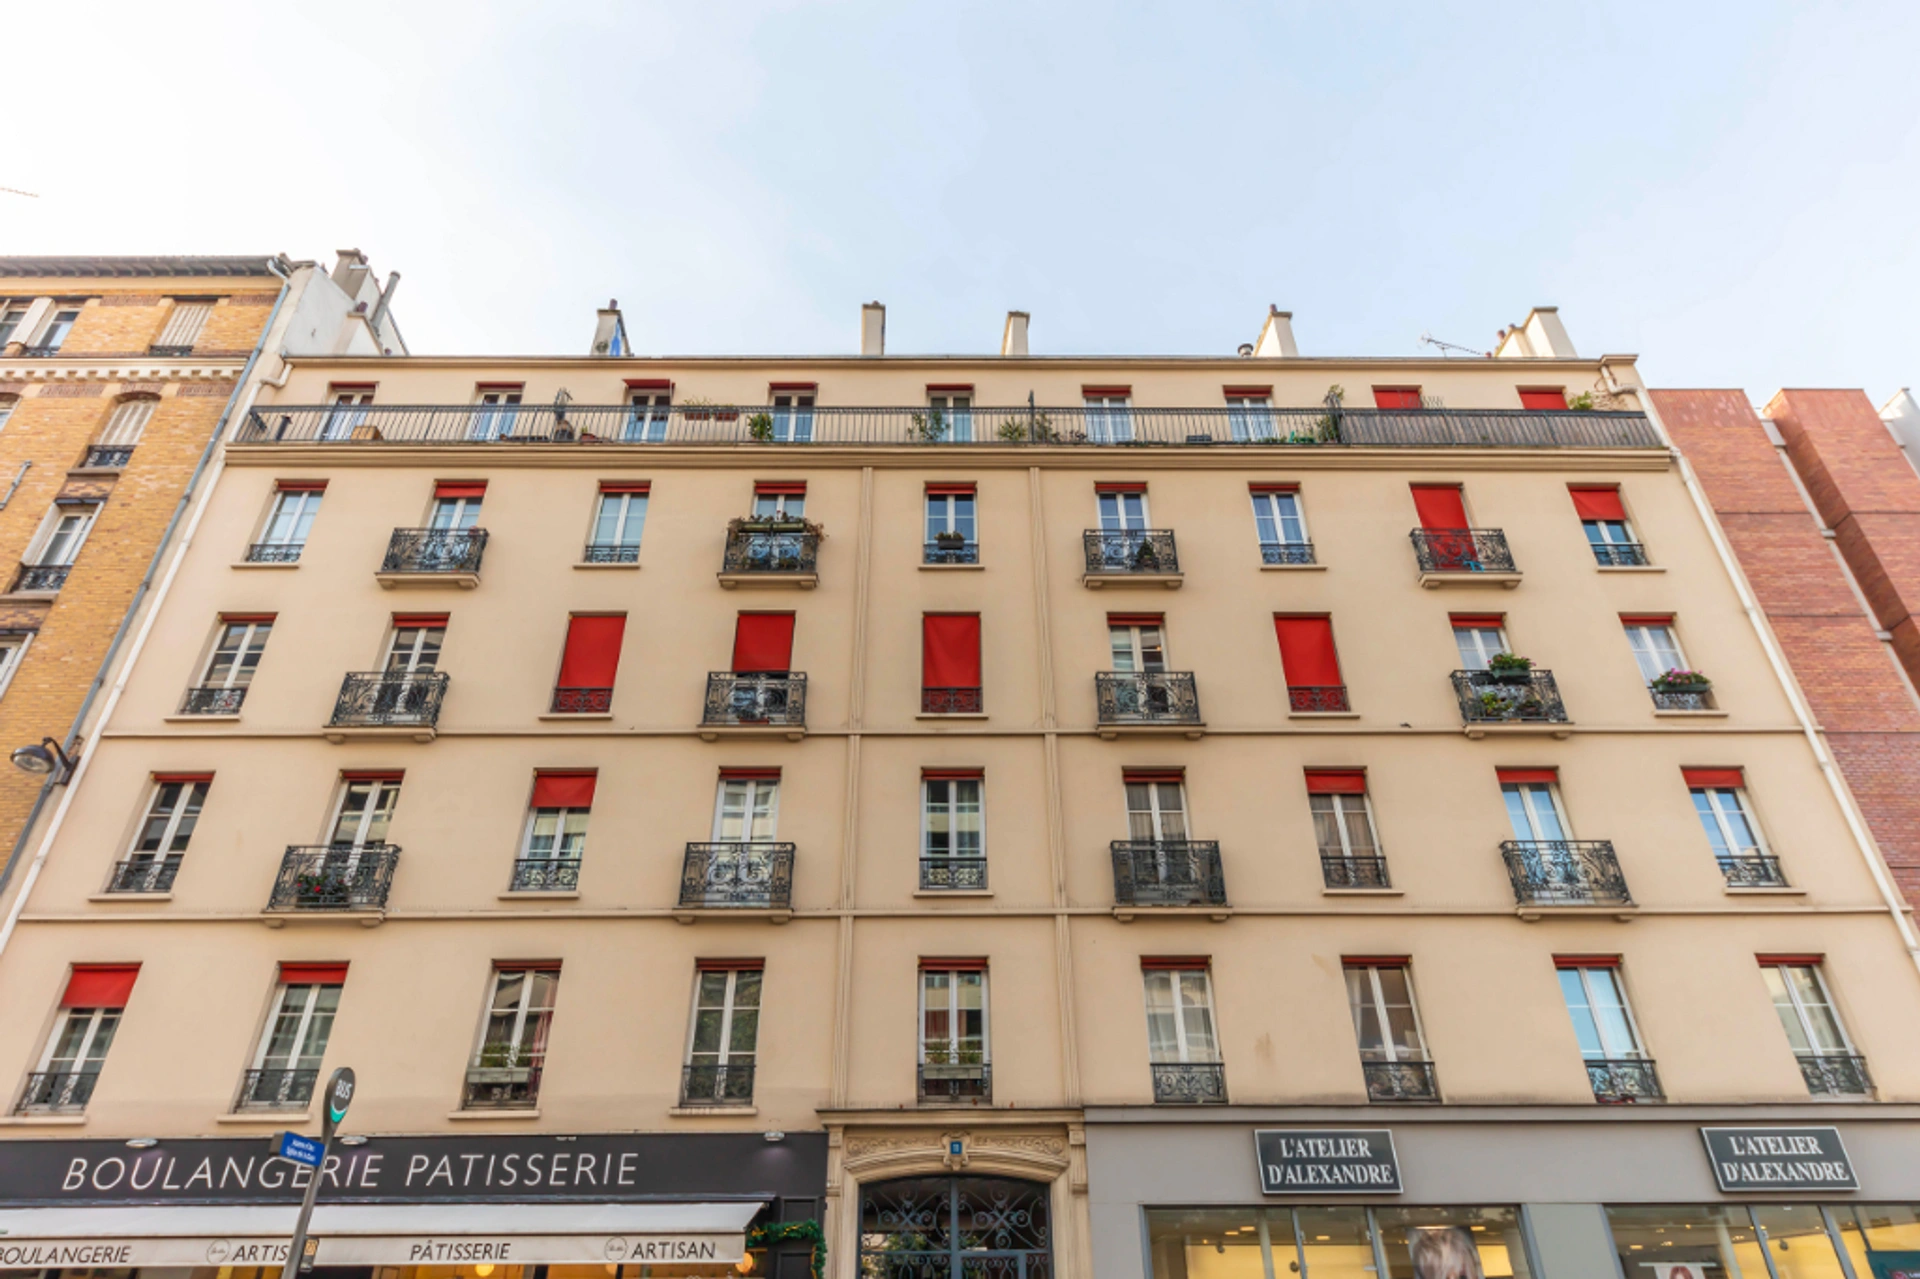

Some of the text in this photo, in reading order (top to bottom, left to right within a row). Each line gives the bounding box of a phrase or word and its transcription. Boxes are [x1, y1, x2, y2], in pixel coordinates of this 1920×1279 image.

[335, 1079, 352, 1100] BUS
[1280, 1138, 1372, 1158] L'ATELIER
[1729, 1136, 1823, 1156] L'ATELIER
[62, 1152, 639, 1190] BOULANGERIE PATISSERIE
[1268, 1164, 1394, 1185] D'ALEXANDRE
[1722, 1162, 1849, 1182] D'ALEXANDRE
[232, 1245, 290, 1261] ARTIS
[410, 1239, 511, 1261] PÂTISSERIE
[631, 1241, 716, 1259] ARTISAN
